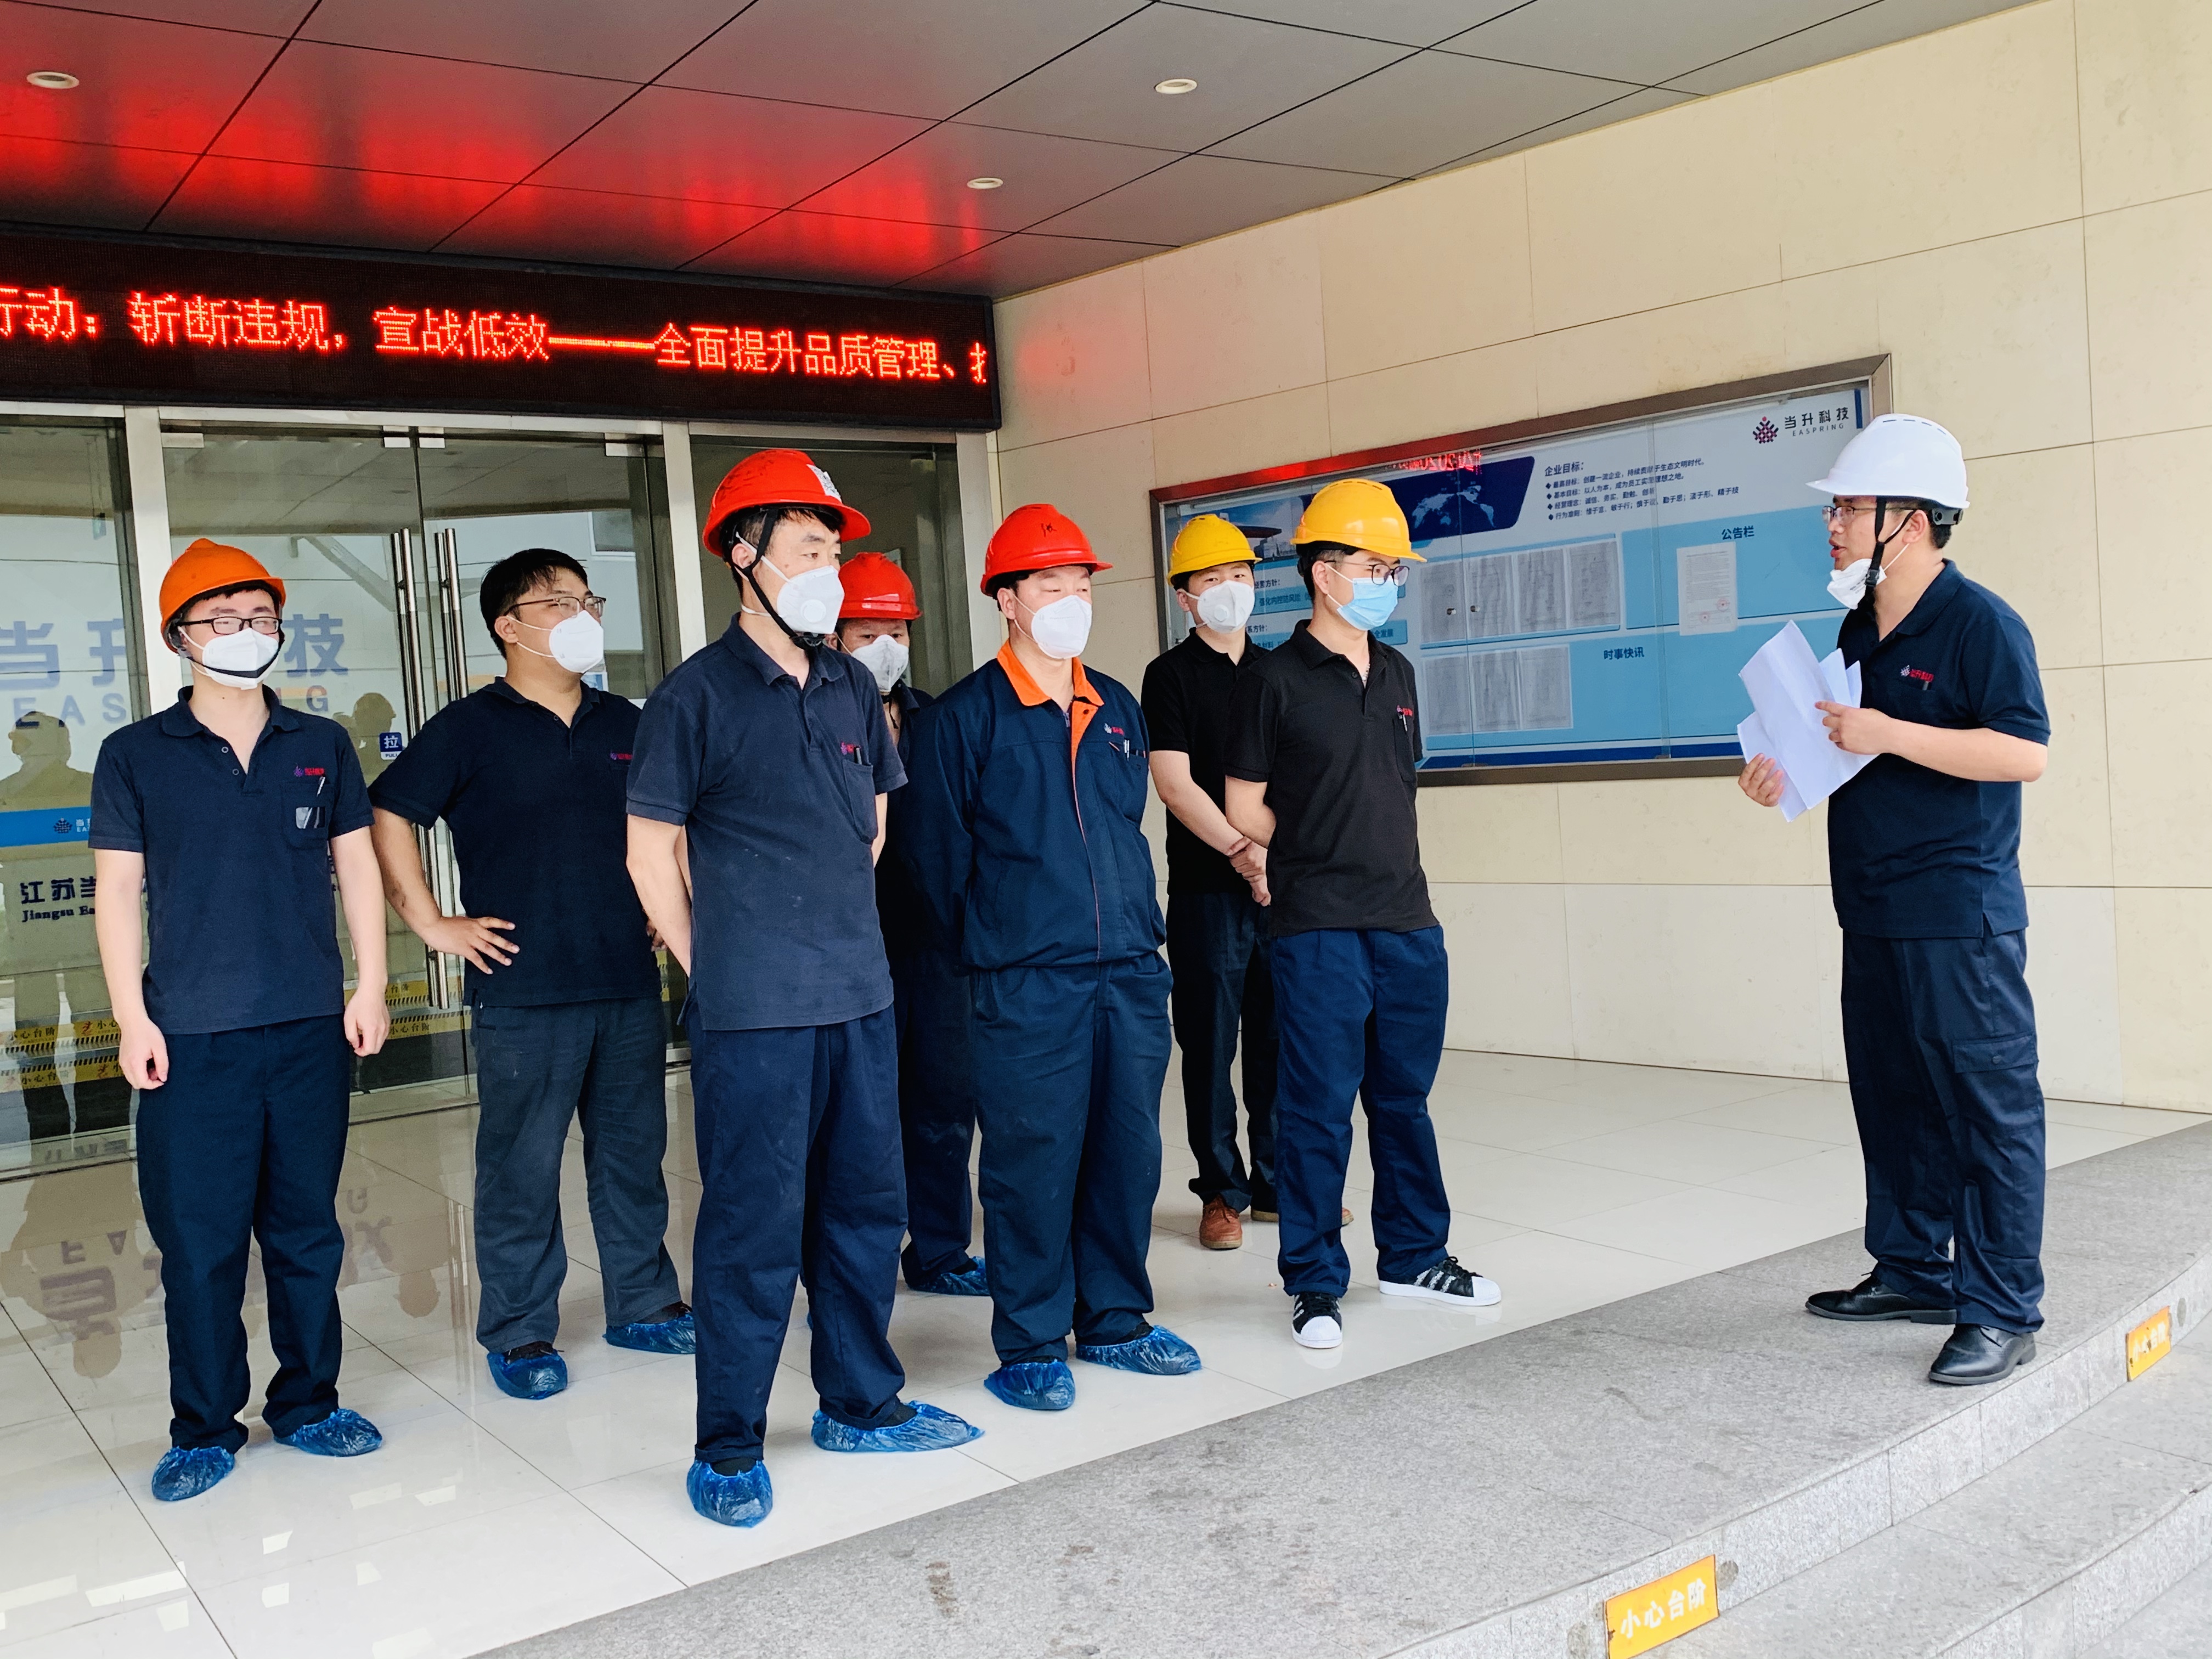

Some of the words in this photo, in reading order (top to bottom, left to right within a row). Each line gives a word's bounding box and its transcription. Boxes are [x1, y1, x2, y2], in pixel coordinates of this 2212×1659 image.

[1785, 407, 1849, 430] 当升科技
[1792, 422, 1844, 436] EASPRING
[1544, 461, 1584, 477] 企业目标：
[1722, 525, 1754, 540] 公告栏
[1604, 647, 1645, 659] 时事快讯
[383, 735, 399, 749] 拉
[21, 908, 75, 923] Jiangsu
[1620, 1577, 1706, 1639] 小心台阶
